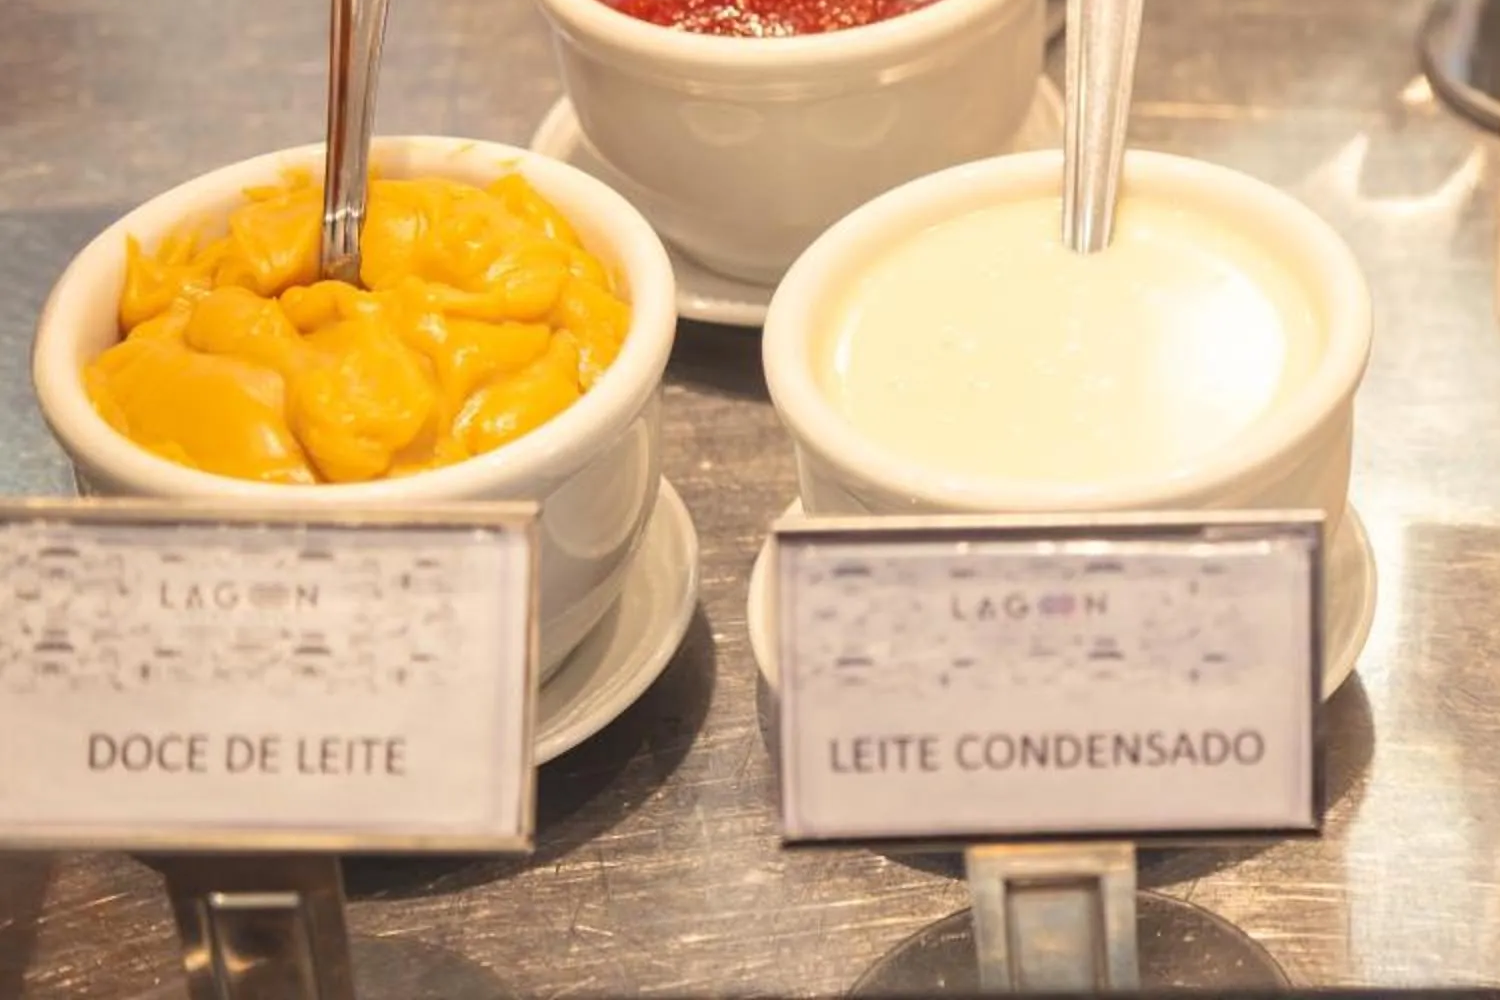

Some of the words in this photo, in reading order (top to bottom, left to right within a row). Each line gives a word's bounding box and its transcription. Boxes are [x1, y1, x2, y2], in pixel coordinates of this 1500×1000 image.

[88, 733, 209, 772] DOCE
[225, 734, 281, 773] DE
[297, 737, 408, 776] LEITE
[830, 737, 940, 773] LEITE
[955, 729, 1266, 770] CONDENSADO
